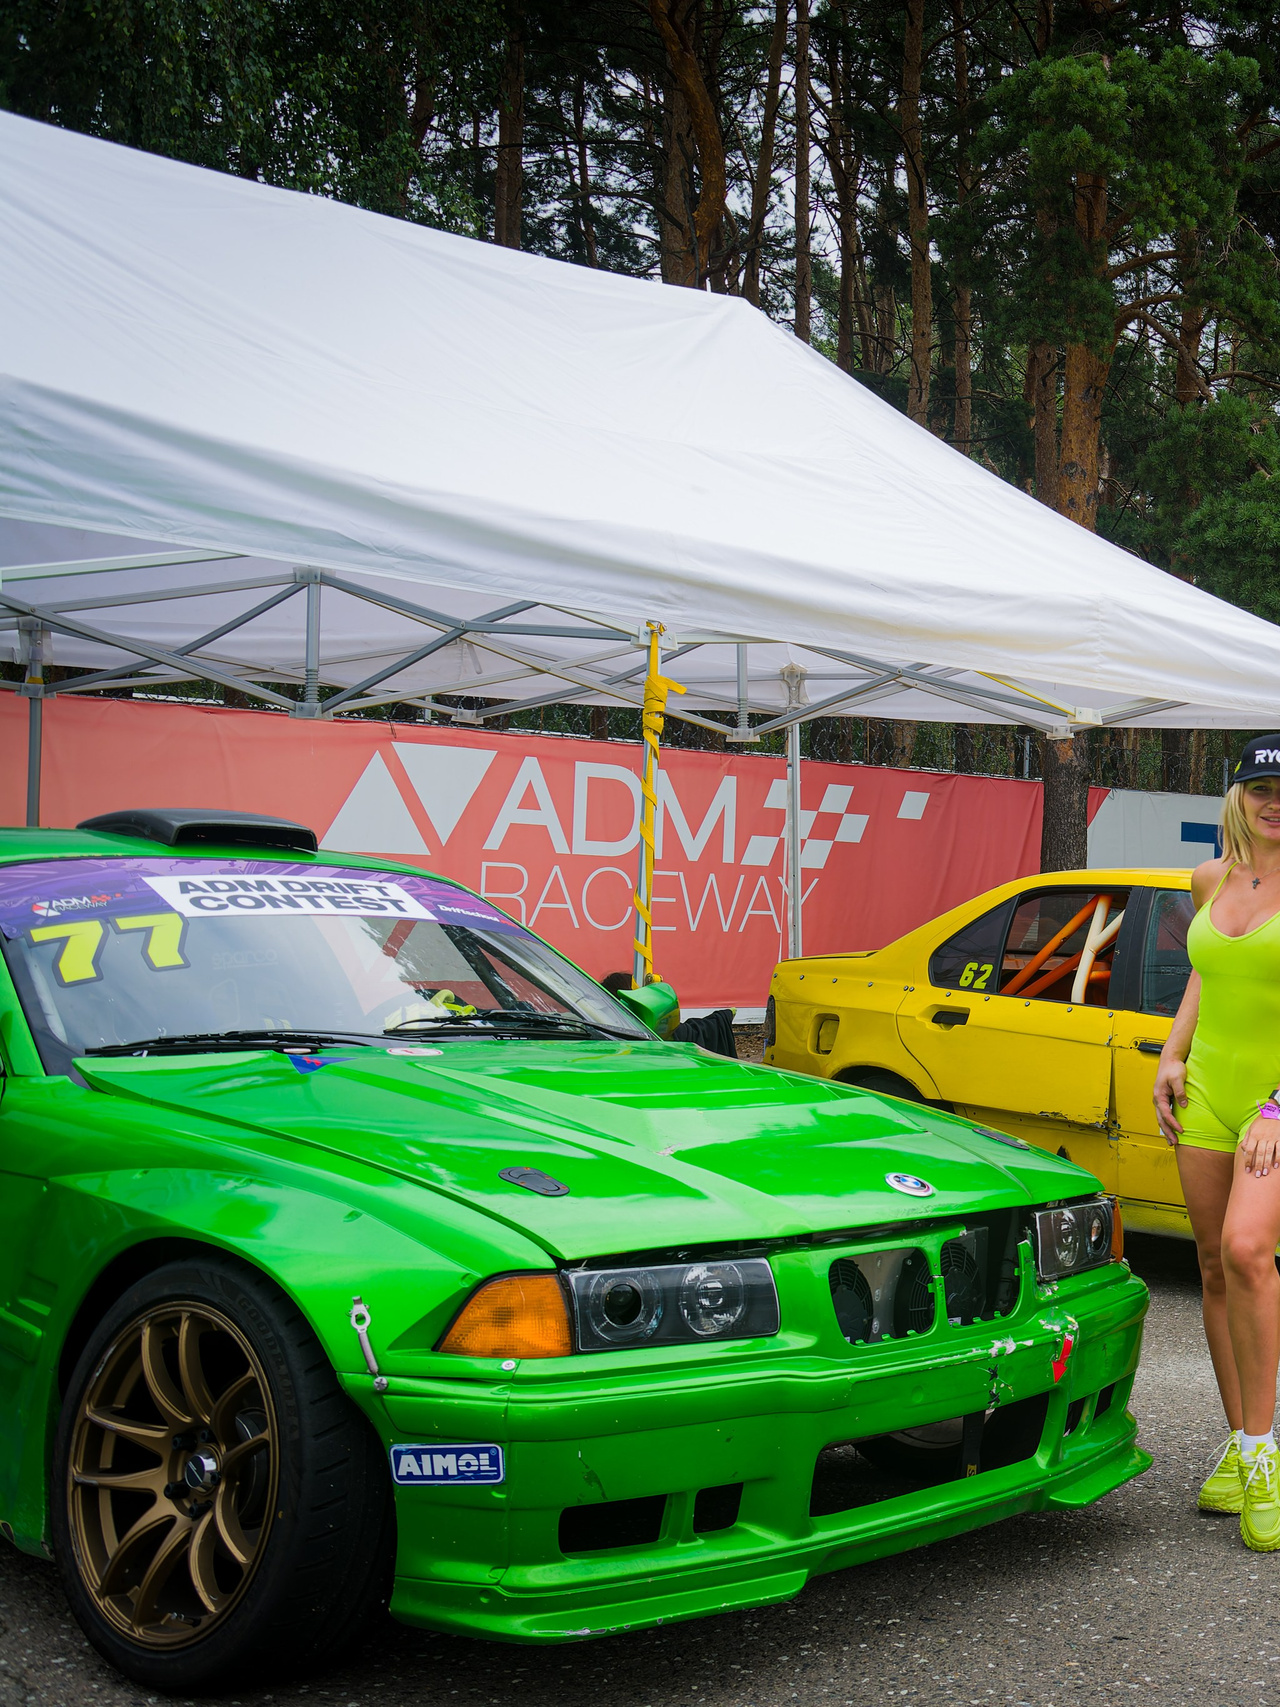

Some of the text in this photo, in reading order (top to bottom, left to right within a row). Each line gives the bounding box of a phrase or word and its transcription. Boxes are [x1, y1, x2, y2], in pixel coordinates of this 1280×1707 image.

[482, 756, 738, 863] ADM
[178, 880, 393, 897] ADM DRIFT
[480, 861, 819, 934] RACEWAY
[52, 895, 93, 908] ADM
[188, 894, 408, 913] CONTEST
[30, 912, 185, 984] 77
[959, 962, 994, 989] 62
[397, 1453, 498, 1476] AIMOL
